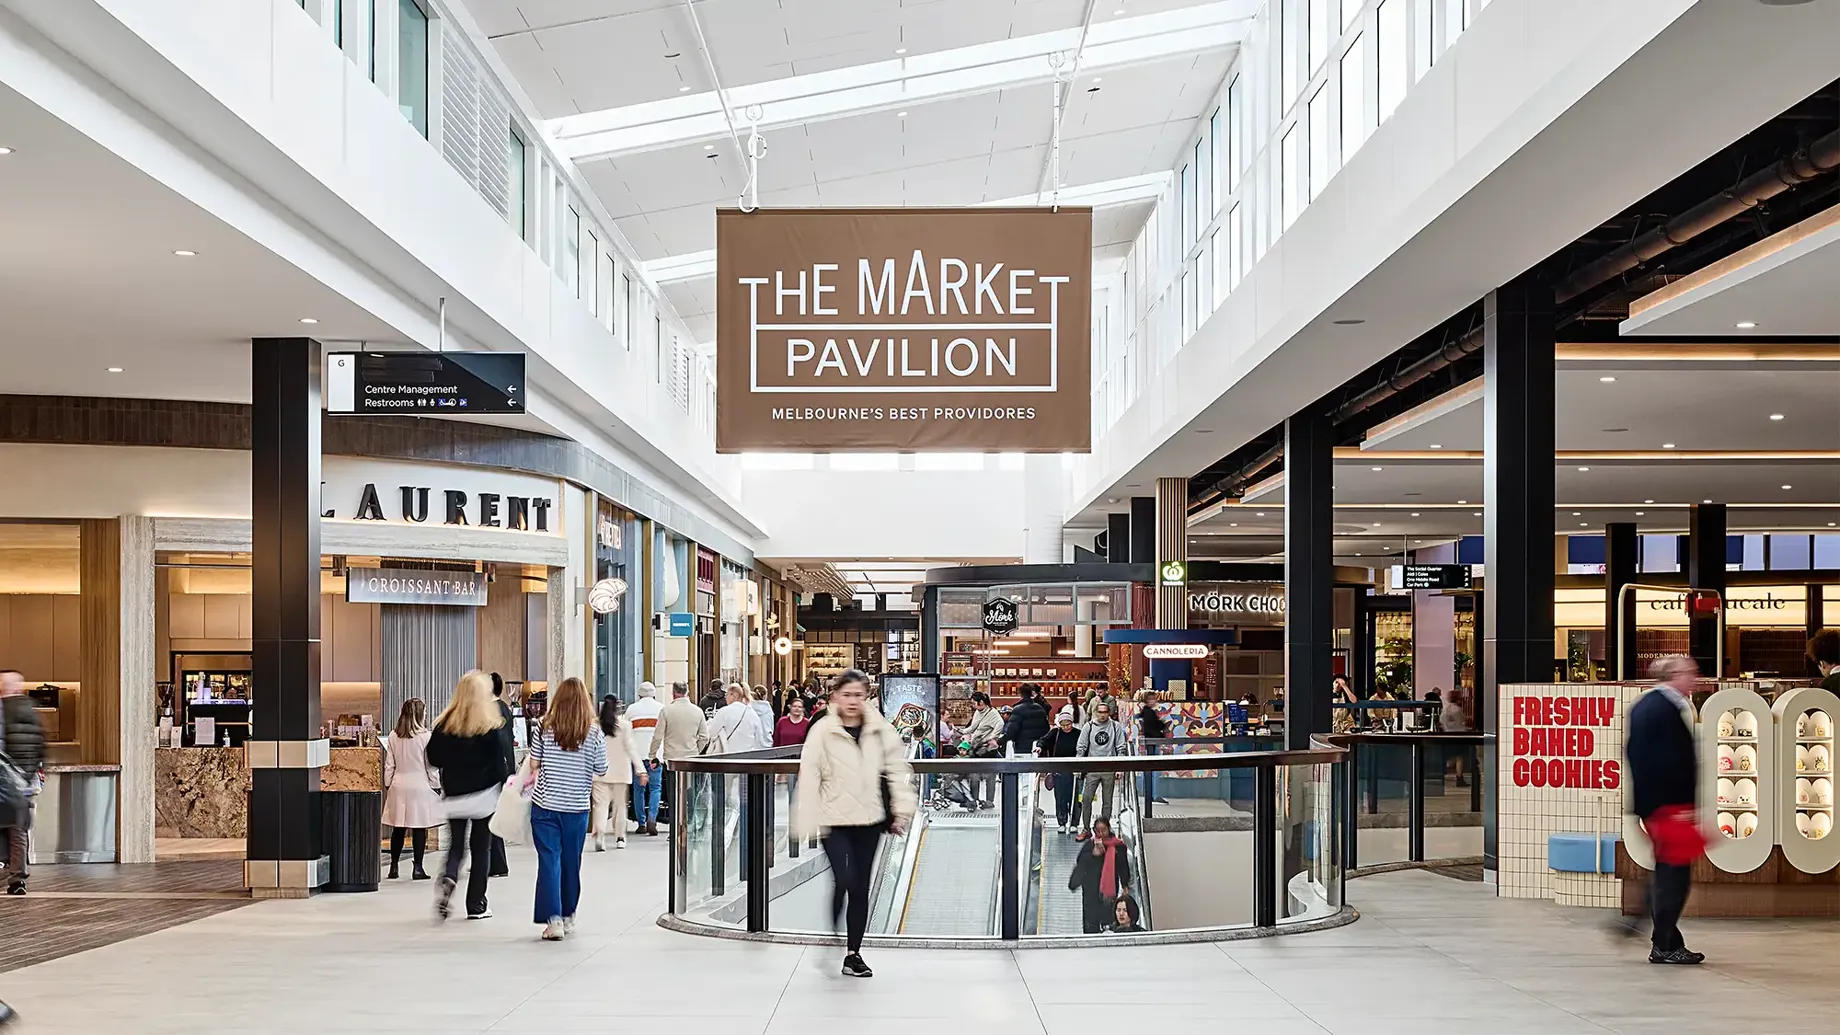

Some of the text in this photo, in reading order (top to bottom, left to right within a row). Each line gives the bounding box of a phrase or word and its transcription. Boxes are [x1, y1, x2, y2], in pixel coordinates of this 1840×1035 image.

[739, 249, 1070, 318] THE MARKET
[337, 359, 345, 368] G
[787, 338, 1017, 377] PAVILION
[365, 385, 458, 397] Centre Management
[365, 398, 415, 408] Restrooms
[889, 408, 929, 420] BEST
[934, 407, 1036, 420] PROVIDORES
[368, 577, 476, 596] CROISSANT BAR
[1191, 591, 1243, 611] MÖRK
[1650, 592, 1785, 611] caf ucale
[1146, 647, 1205, 655] CANNOLERIA
[1513, 696, 1616, 726] FRESHLY
